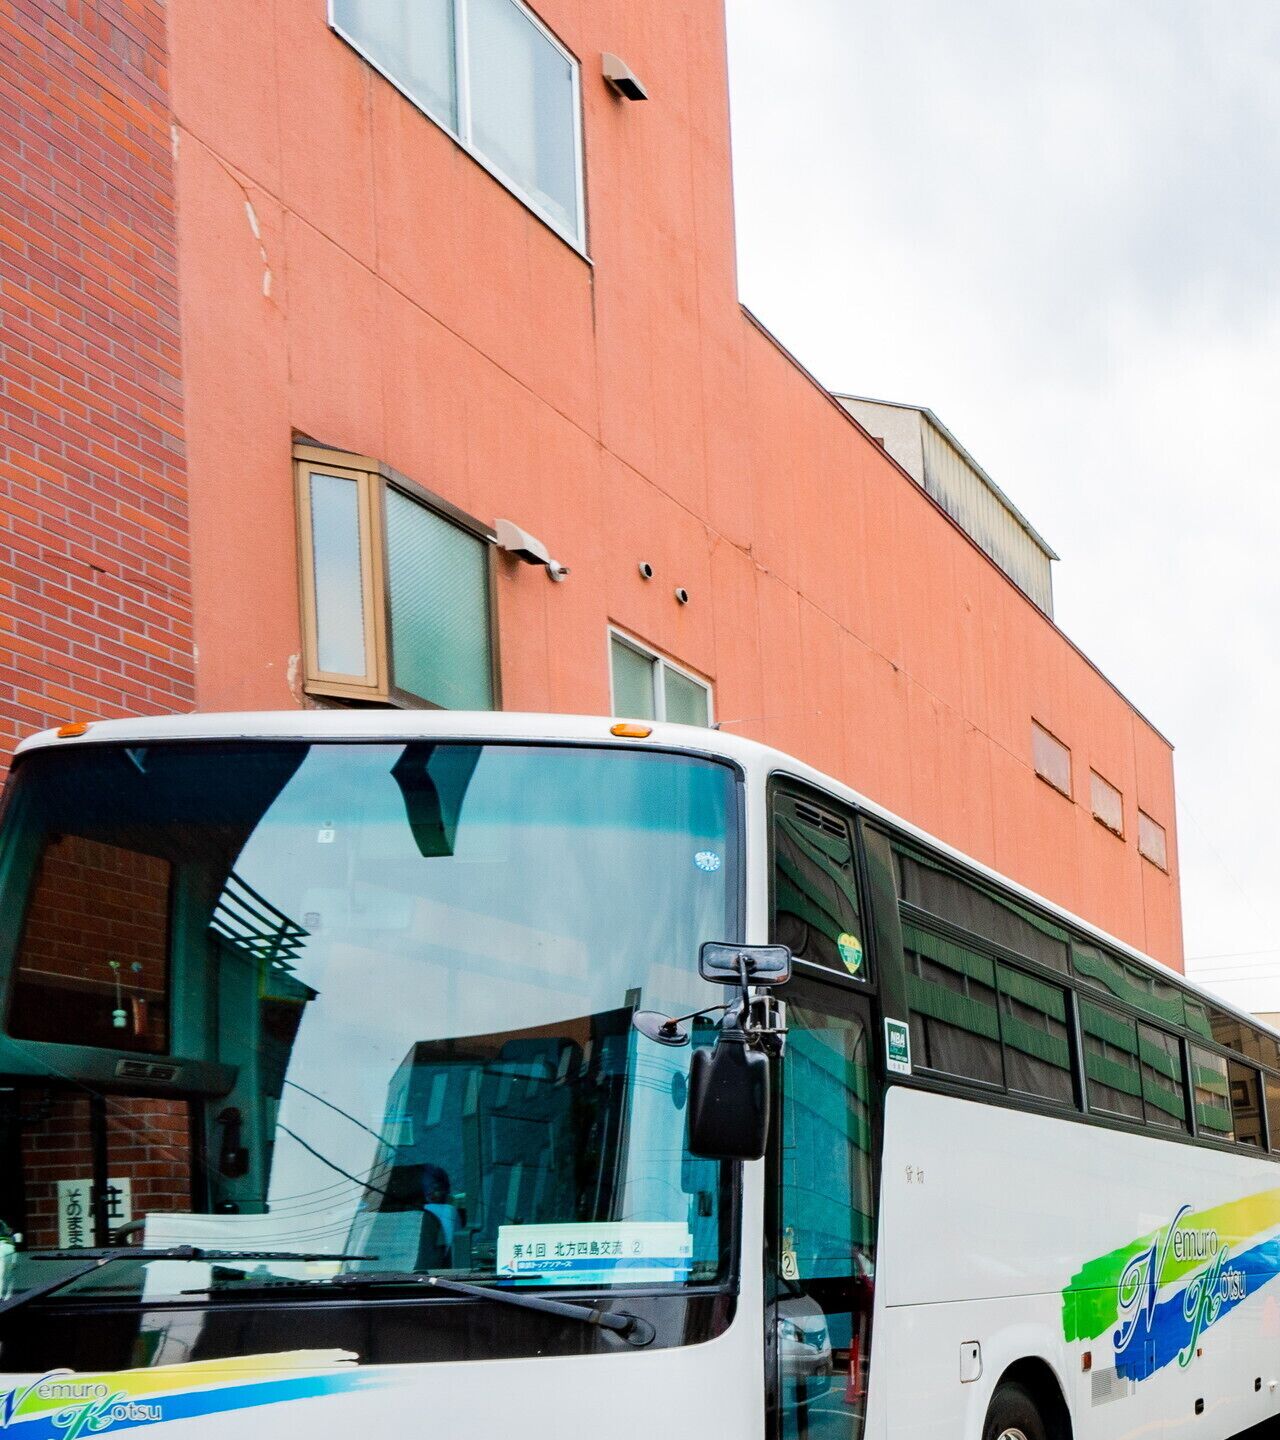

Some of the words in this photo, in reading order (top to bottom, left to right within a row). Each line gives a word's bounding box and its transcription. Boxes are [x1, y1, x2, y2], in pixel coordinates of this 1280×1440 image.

[513, 1243, 546, 1258] 第4回
[554, 1241, 624, 1257] 北方四島交流
[1113, 1204, 1218, 1353] Nemuro
[1179, 1244, 1247, 1367] Kotsu
